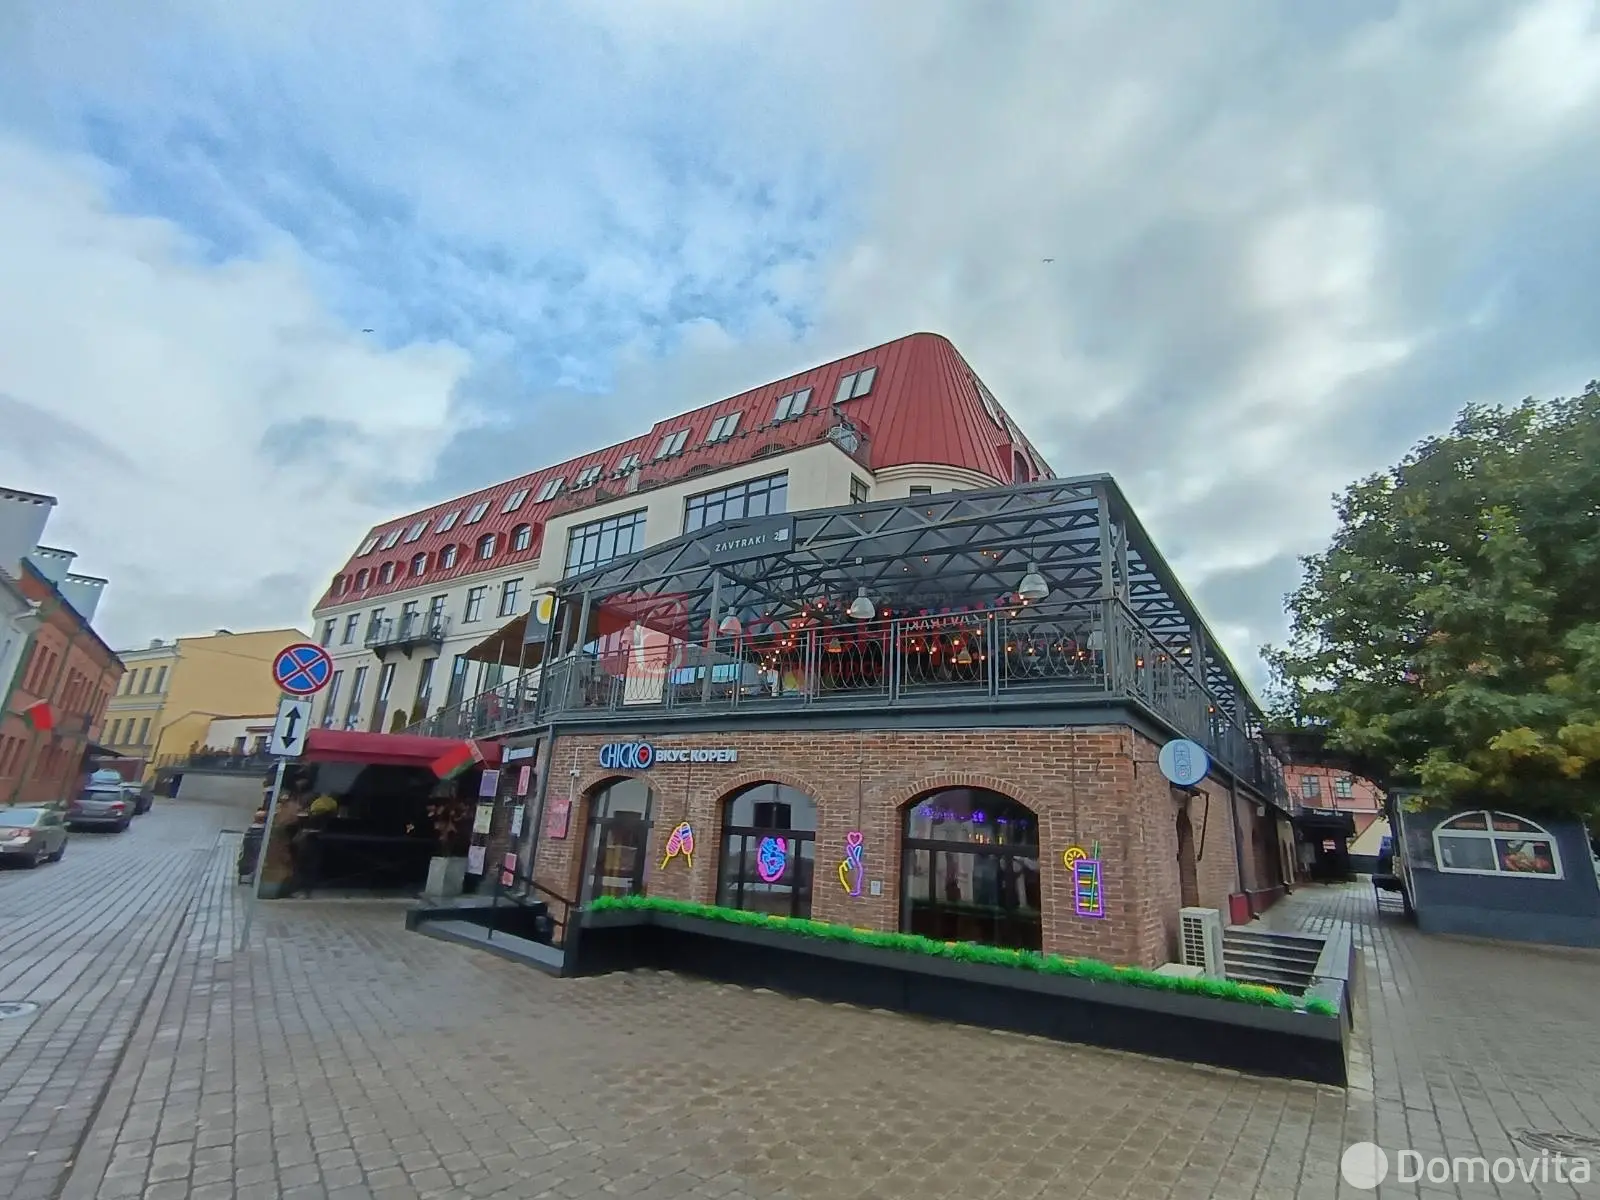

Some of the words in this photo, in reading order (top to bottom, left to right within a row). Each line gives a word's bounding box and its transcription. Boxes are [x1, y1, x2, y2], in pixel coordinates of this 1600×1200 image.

[715, 534, 766, 552] ZAVTRAKI
[599, 743, 653, 768] CHICKO
[655, 750, 690, 762] ВКУС
